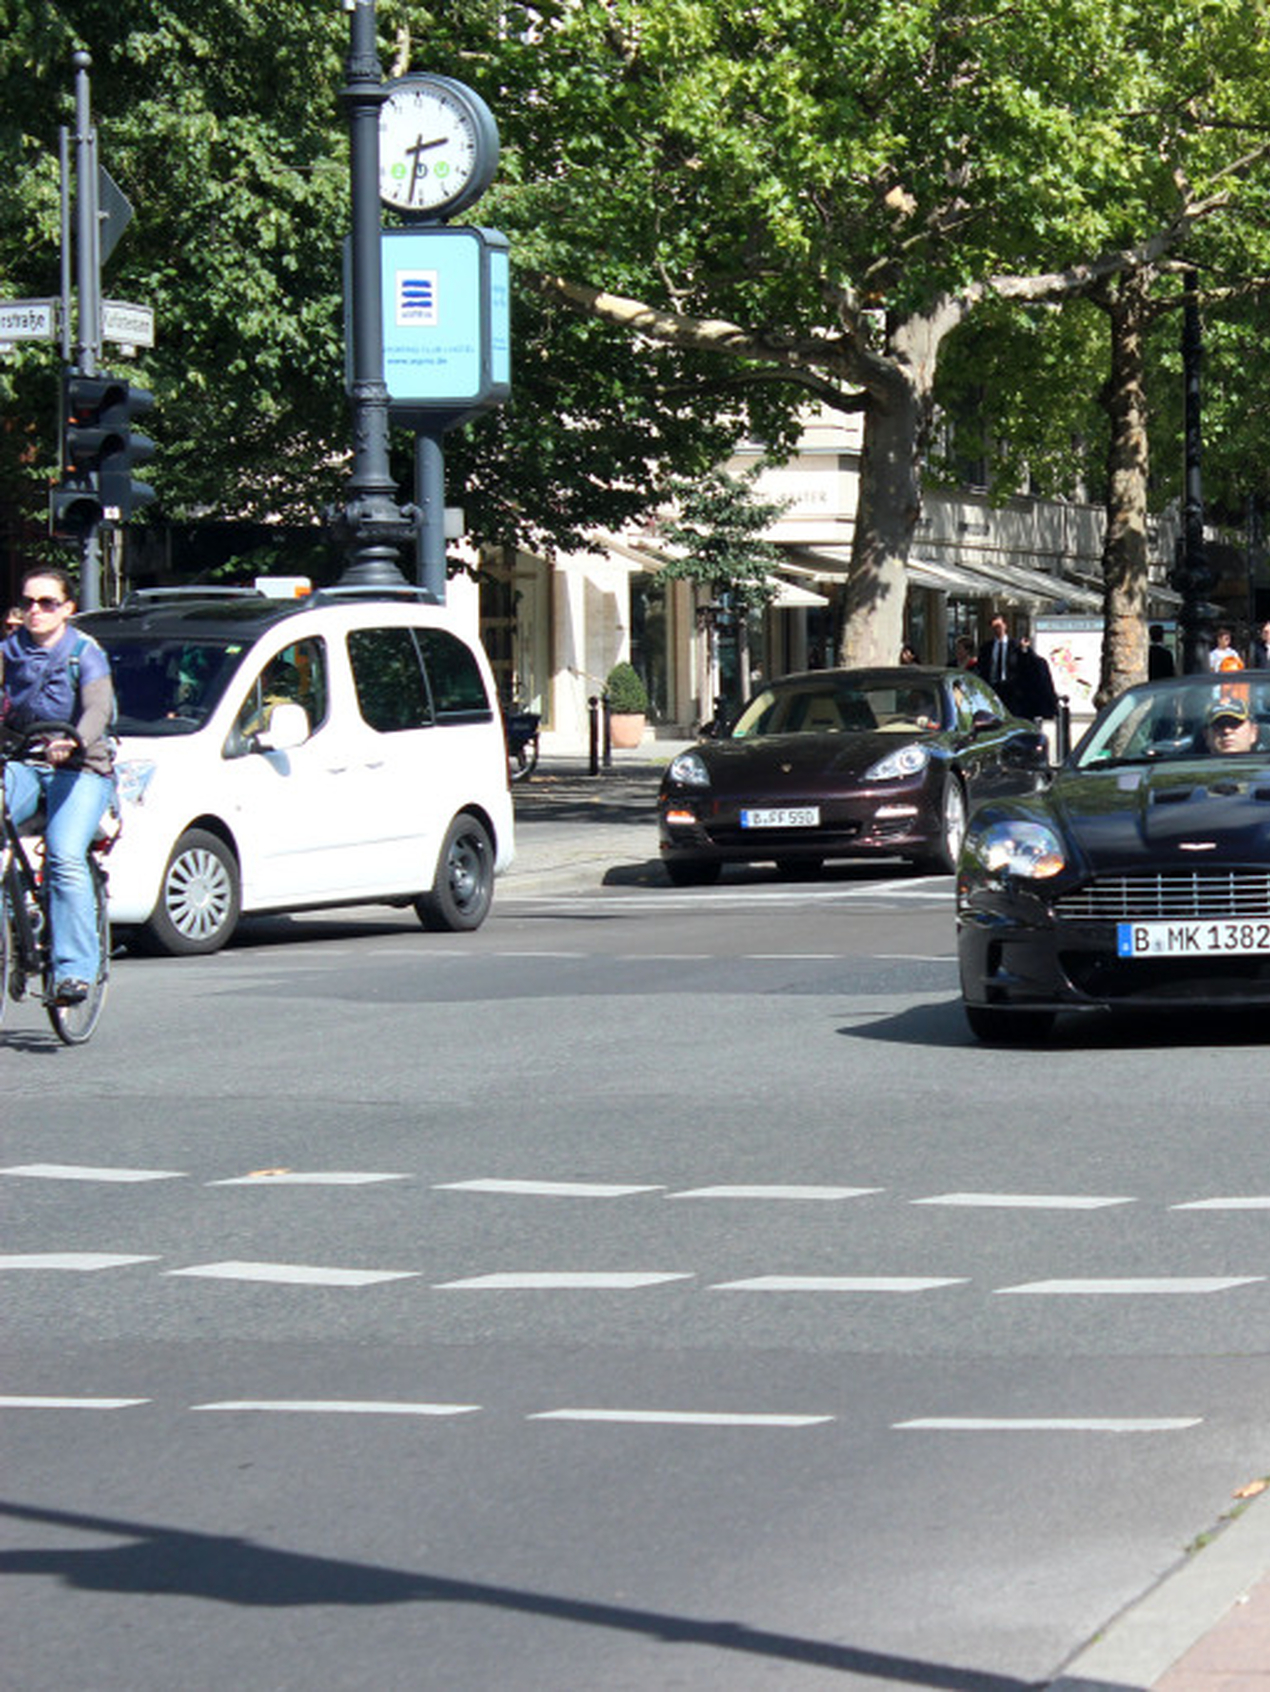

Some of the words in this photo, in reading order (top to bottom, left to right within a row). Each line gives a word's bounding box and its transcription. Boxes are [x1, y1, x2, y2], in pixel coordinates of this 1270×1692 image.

[1135, 927, 1150, 952] B
[1168, 926, 1202, 951] MK
[1207, 924, 1270, 950] 1382
